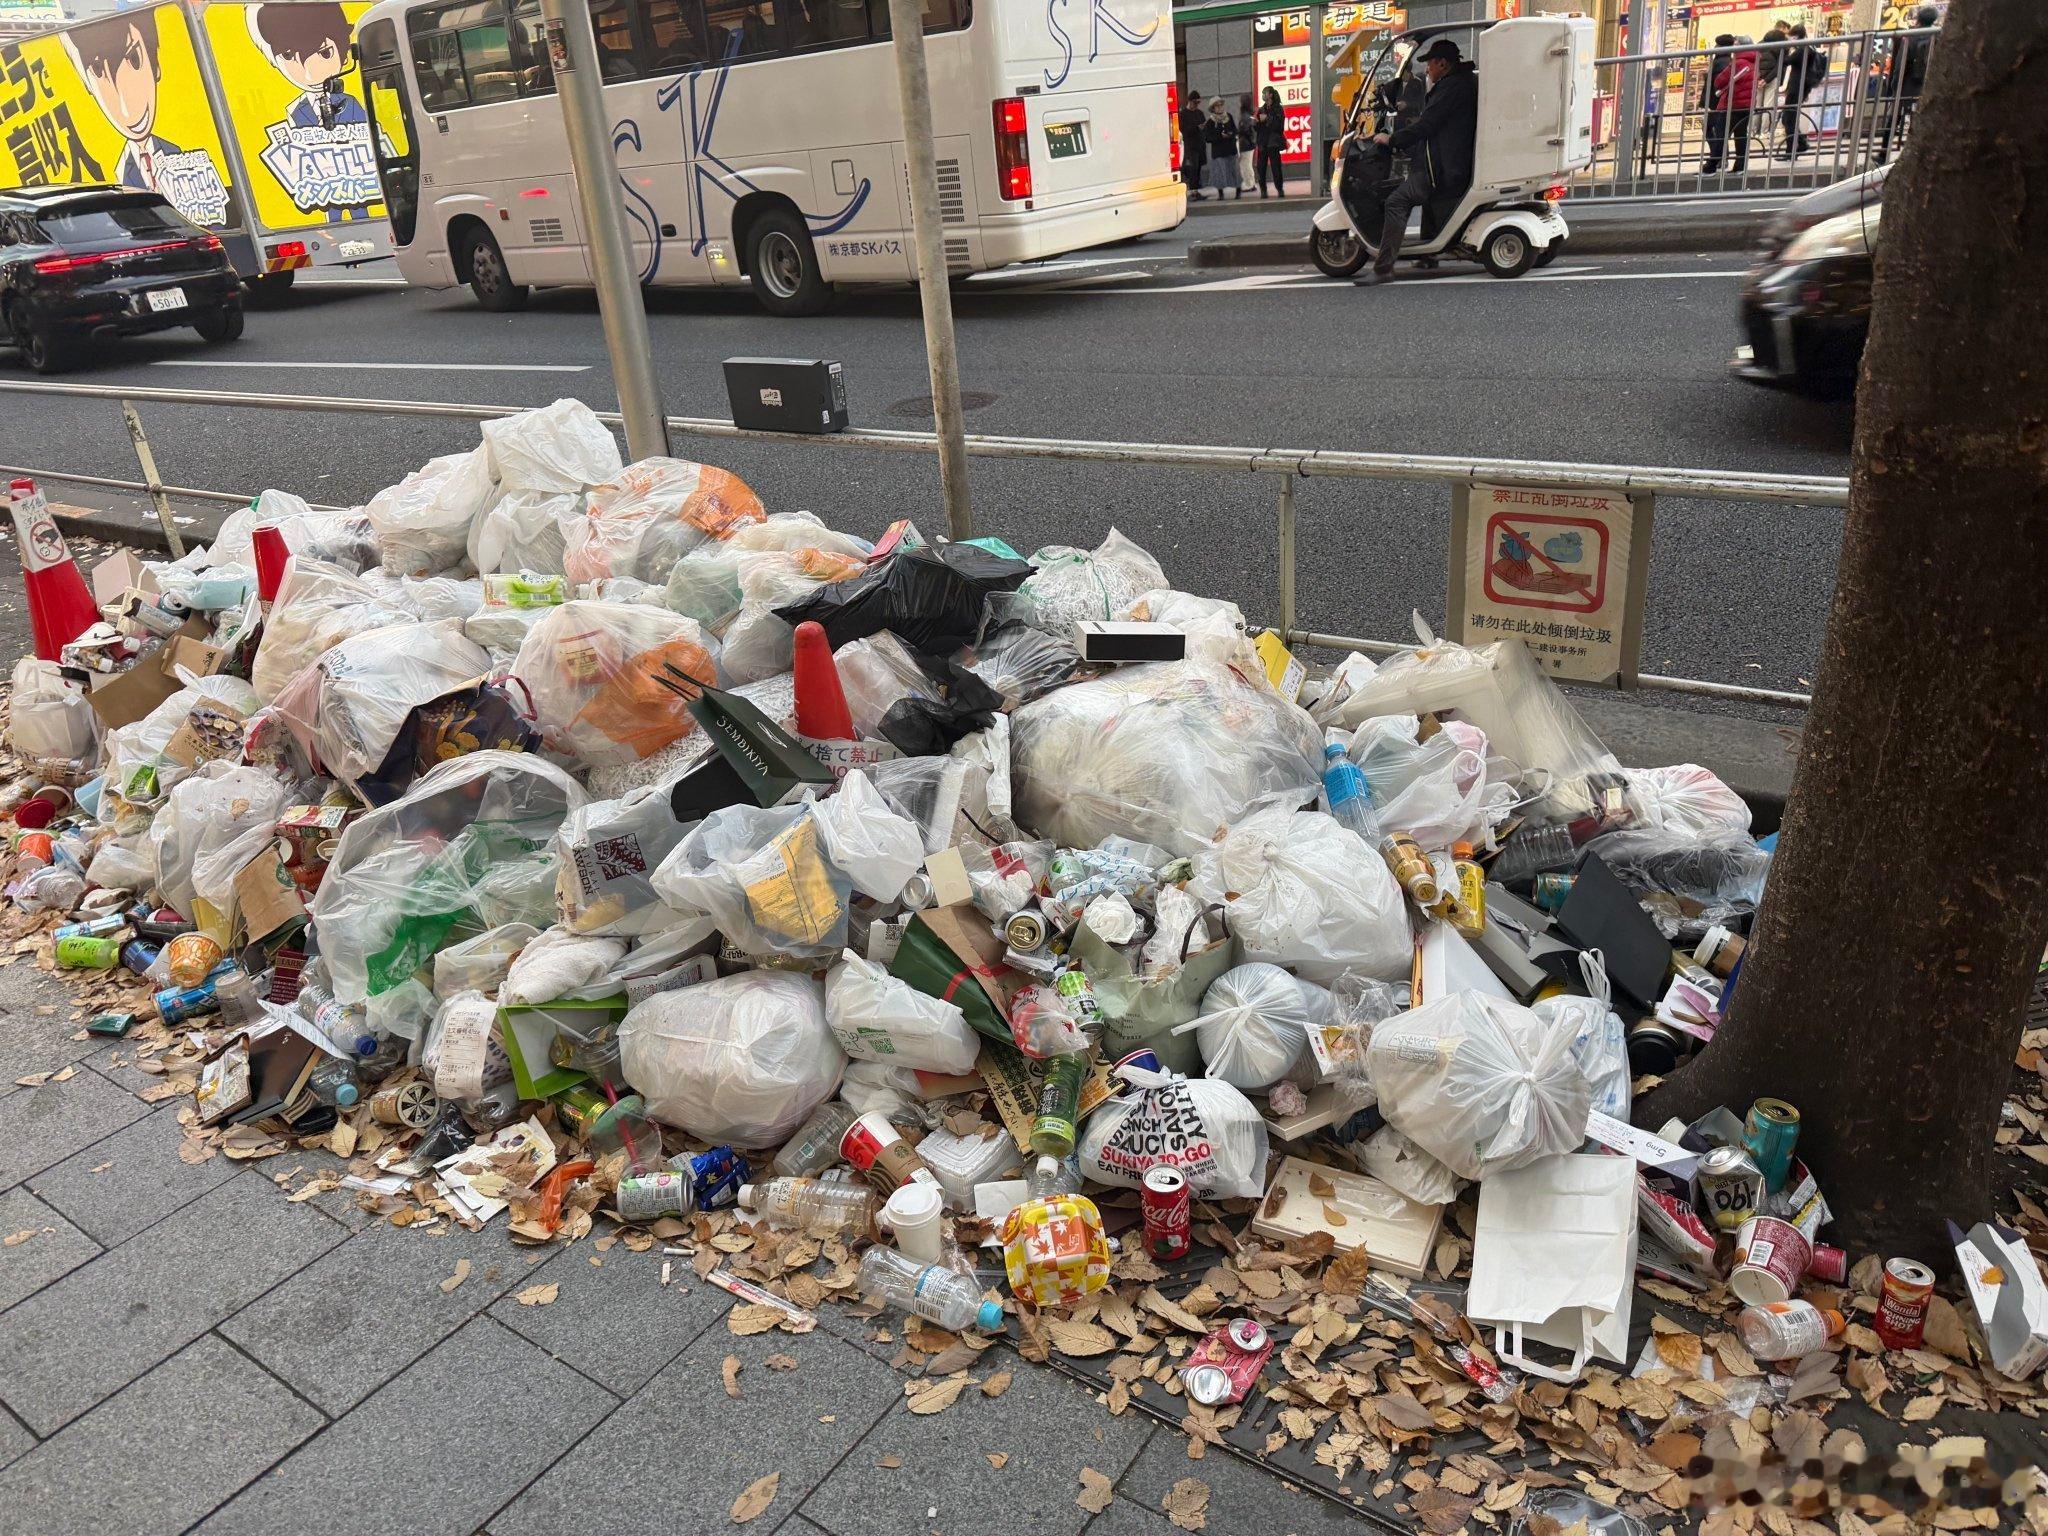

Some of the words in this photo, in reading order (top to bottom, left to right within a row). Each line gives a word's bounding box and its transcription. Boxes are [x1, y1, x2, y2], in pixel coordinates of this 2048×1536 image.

[1287, 87, 1310, 100] BIC
[1493, 490, 1611, 511] 禁止乱倒垃圾
[1471, 613, 1612, 644] 请勿在此处倾倒垃圾
[1525, 641, 1587, 657] 二建设事务所
[716, 715, 769, 776] SEMBIKIYA
[1101, 1145, 1155, 1170] SUKIYA
[1158, 1142, 1211, 1165] TO-GO
[1645, 1141, 1667, 1158] 5mg
[1098, 1160, 1121, 1175] EAT
[1194, 1159, 1215, 1169] WHERE
[1206, 1164, 1218, 1173] YOU
[1886, 1297, 1919, 1315] Wonda
[1881, 1306, 1921, 1325] MORNING
[1884, 1316, 1913, 1330] SHOT
